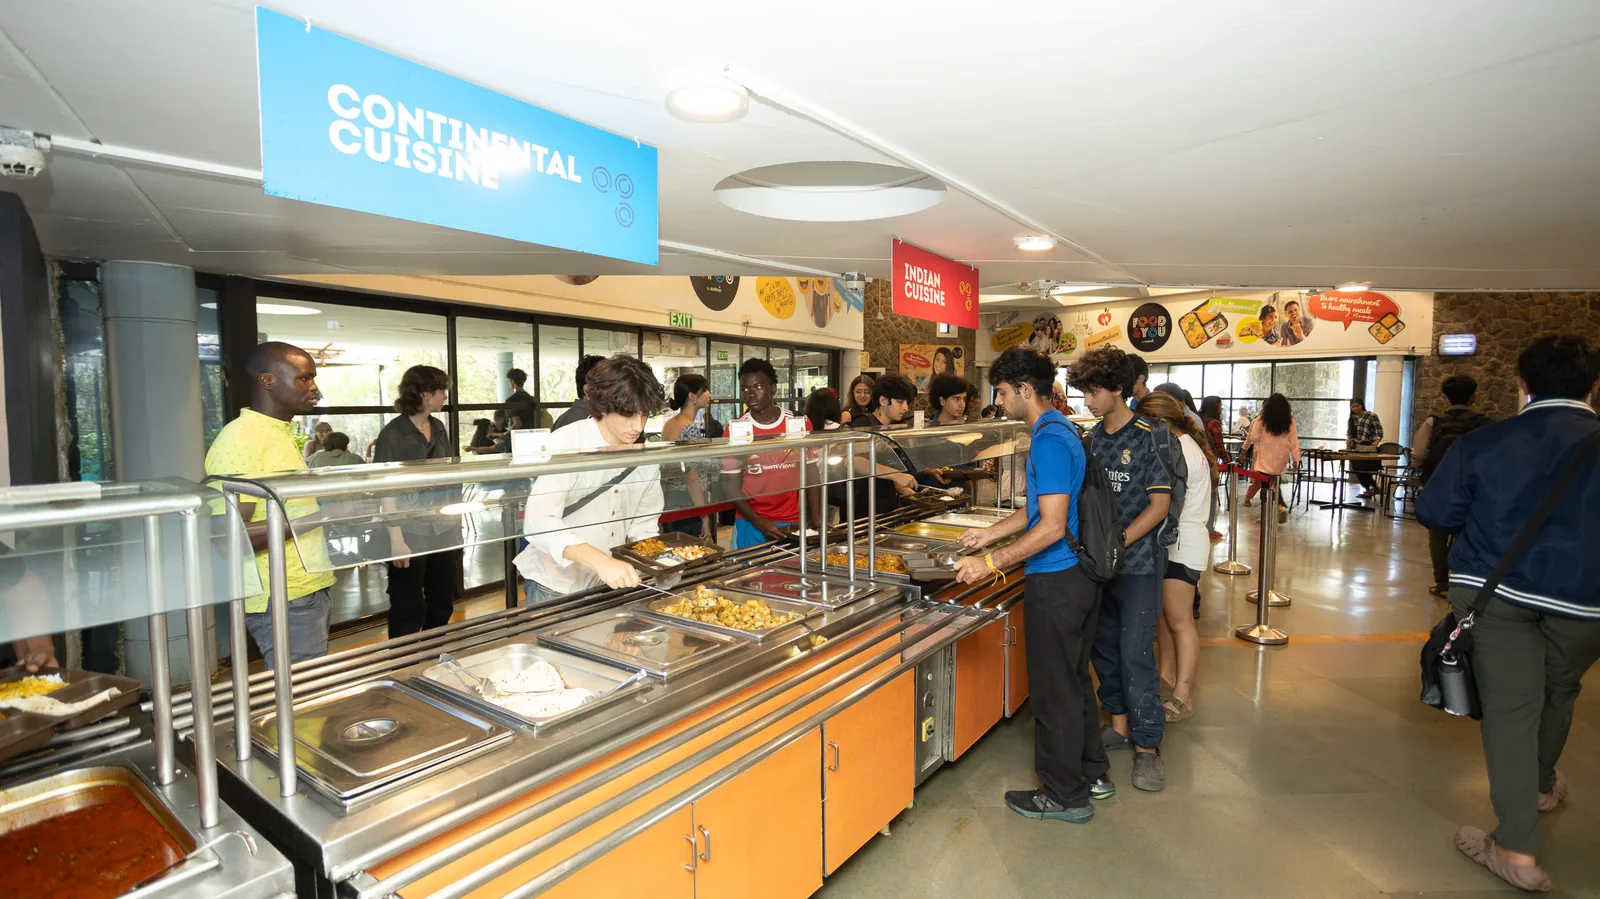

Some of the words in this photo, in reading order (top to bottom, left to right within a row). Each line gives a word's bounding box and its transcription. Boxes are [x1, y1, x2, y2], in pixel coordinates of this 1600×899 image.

[327, 83, 582, 184] CONTINENTAL
[328, 119, 499, 191] CUISINE
[904, 262, 941, 289] INDIAN
[904, 281, 946, 307] CUISINE
[670, 312, 692, 328] EXIT
[1328, 302, 1351, 317] healthy
[1132, 315, 1167, 328] FOOD
[1132, 326, 1166, 338] &YOU
